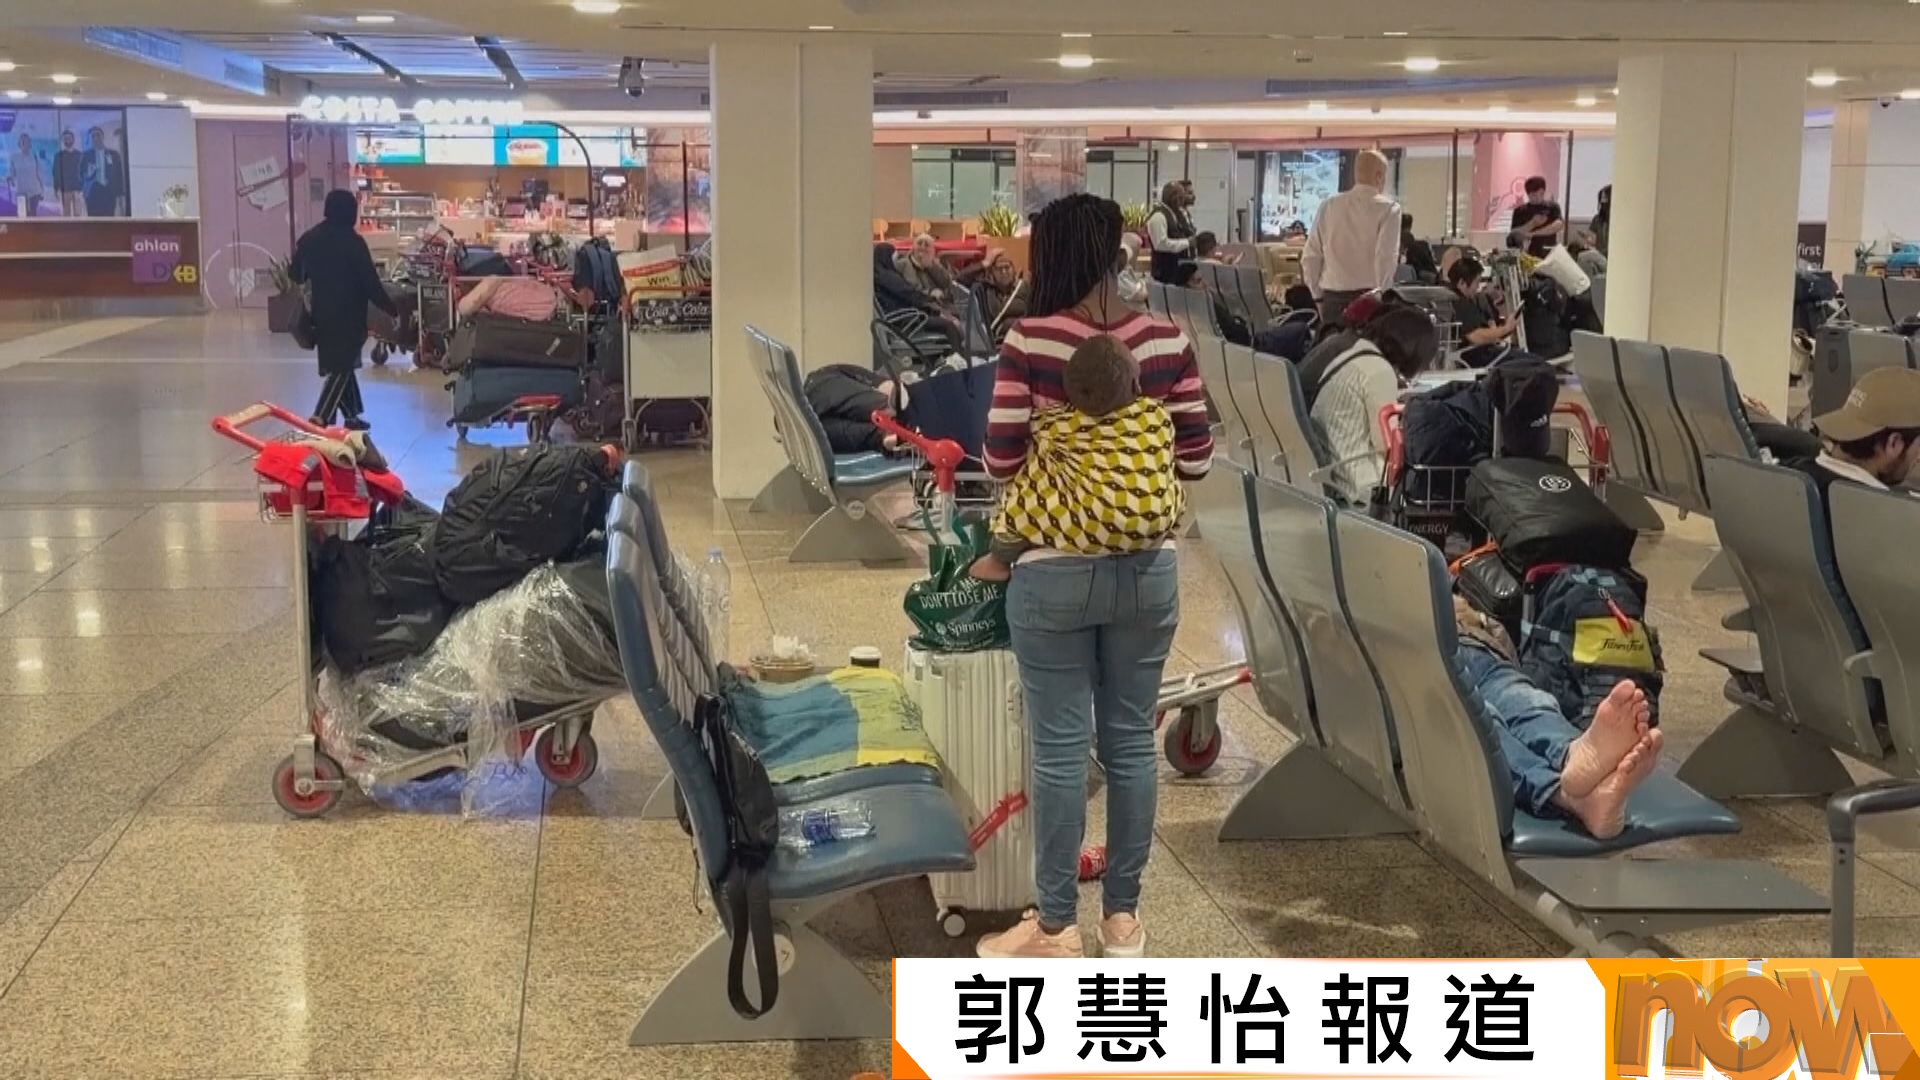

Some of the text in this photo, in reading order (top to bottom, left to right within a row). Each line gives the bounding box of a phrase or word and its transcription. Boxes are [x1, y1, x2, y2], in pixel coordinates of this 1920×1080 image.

[300, 95, 400, 124] COSTA
[135, 239, 179, 252] ahlan
[1797, 242, 1822, 256] first
[951, 588, 981, 608] LOSE
[947, 617, 997, 637] Spinneys
